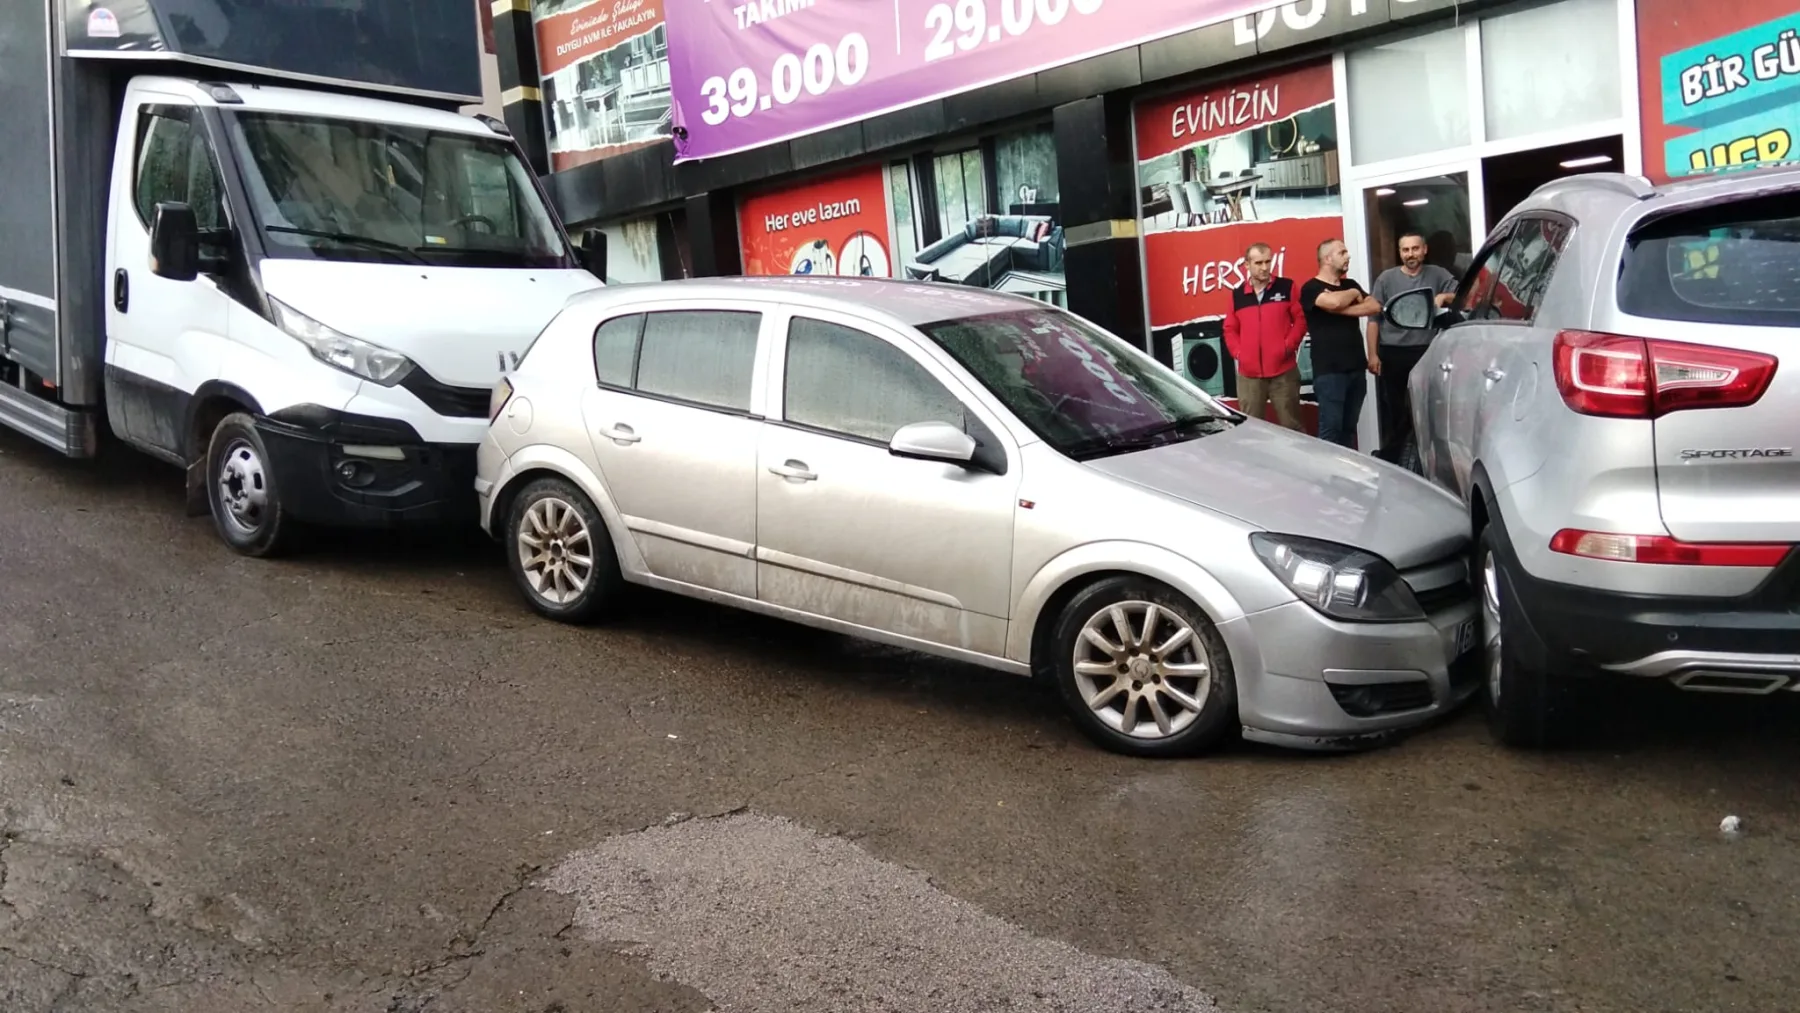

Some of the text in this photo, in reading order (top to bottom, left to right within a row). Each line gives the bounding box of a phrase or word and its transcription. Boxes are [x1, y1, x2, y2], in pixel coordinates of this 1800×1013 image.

[556, 38, 582, 56] DUYGU
[583, 30, 600, 46] AVM
[613, 8, 656, 34] YAKALAYIN
[924, 0, 1101, 62] 29.00
[700, 32, 868, 126] 39.000
[1680, 54, 1750, 106] BİR
[1172, 83, 1279, 138] EVİNİZİN
[765, 198, 861, 232] Her eve lazım
[1680, 447, 1793, 459] SPORTAGE
